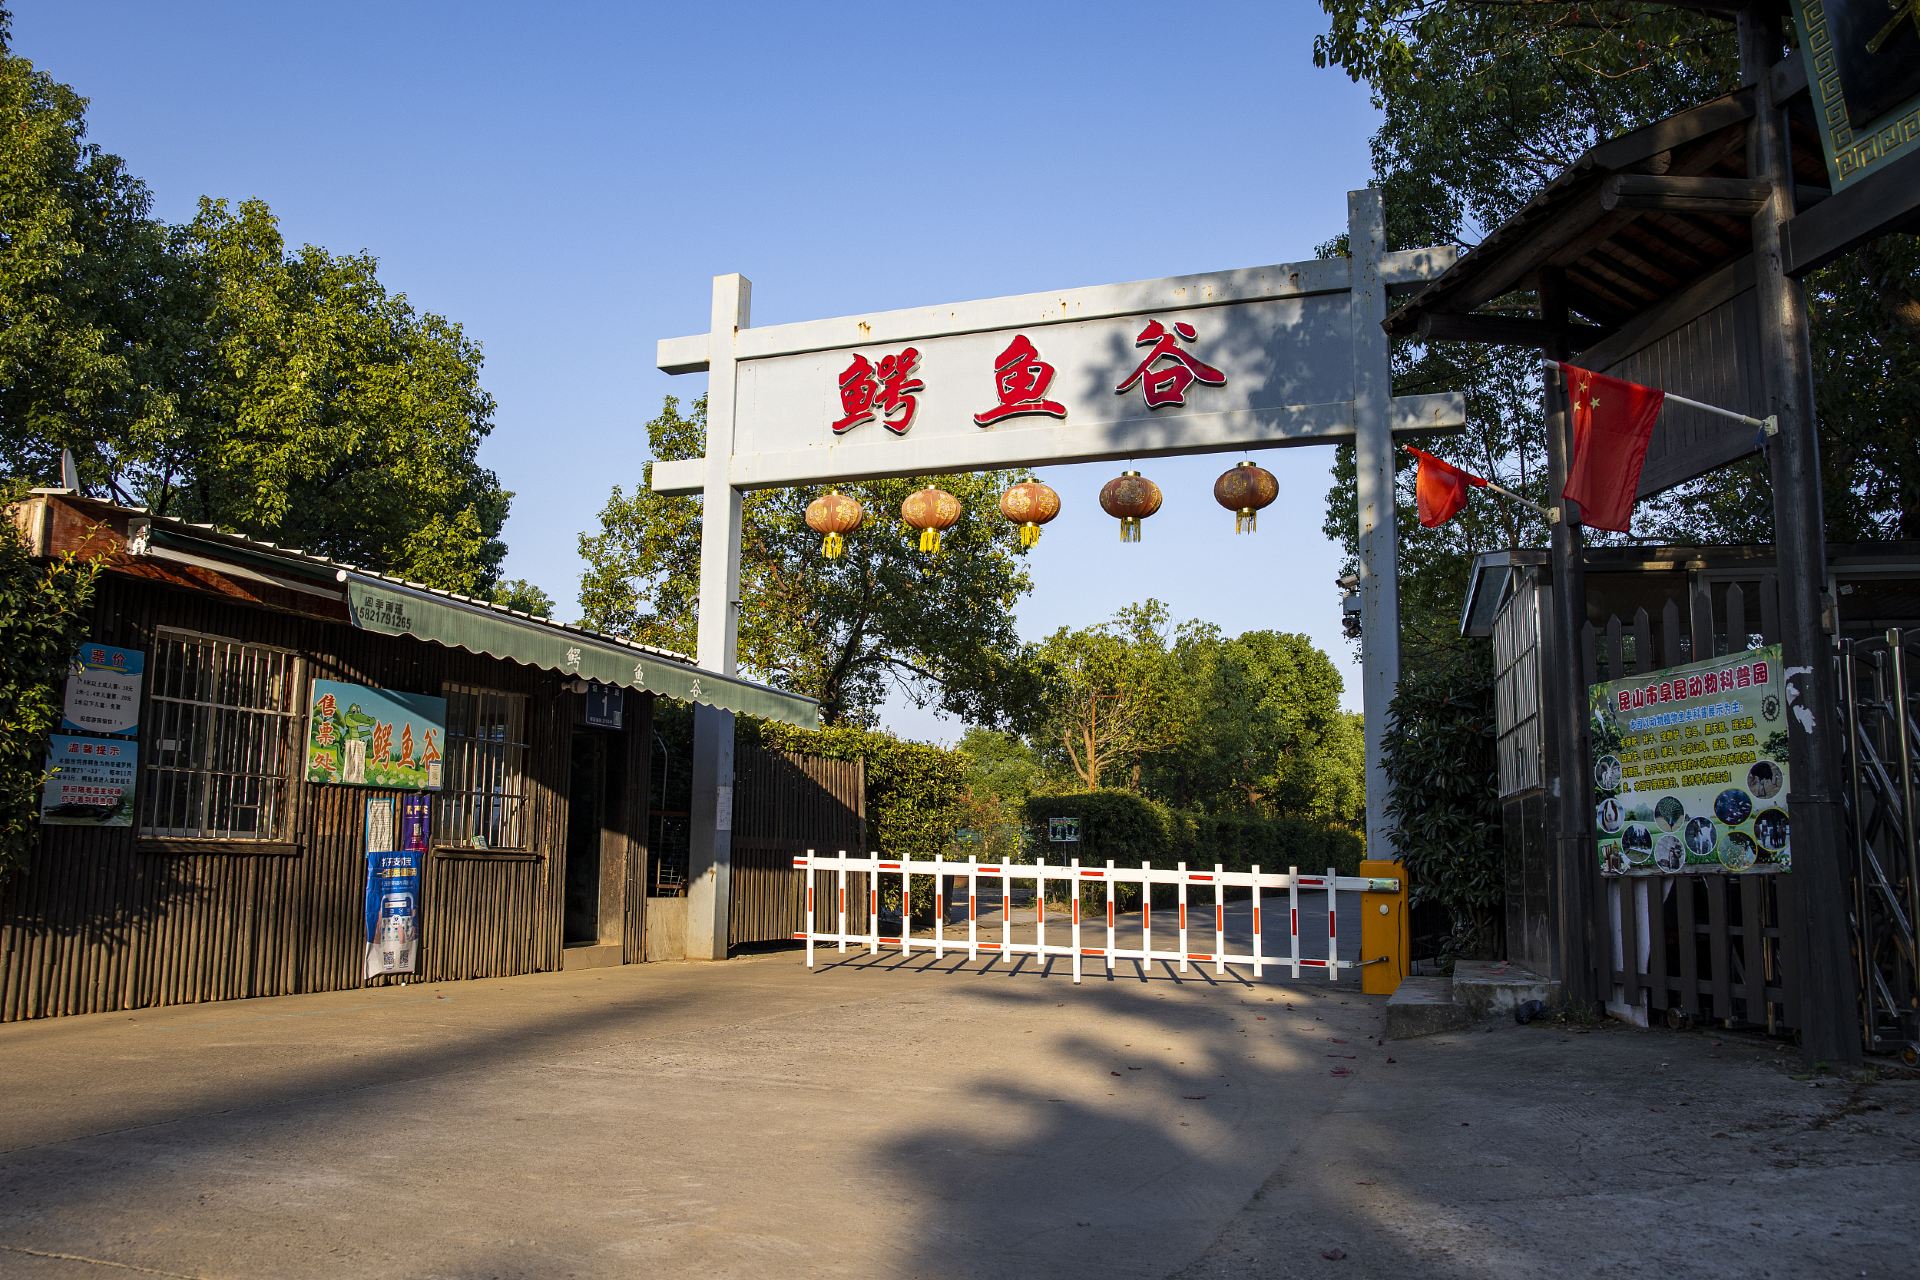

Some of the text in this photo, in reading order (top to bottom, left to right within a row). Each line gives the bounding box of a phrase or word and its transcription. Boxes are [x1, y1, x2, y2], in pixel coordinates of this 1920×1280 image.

[831, 318, 1228, 436] 鳄鱼谷
[91, 649, 125, 667] 票价
[566, 646, 702, 697] 鳄鱼谷
[602, 695, 608, 717] 1
[67, 742, 121, 757] 温馨提示
[313, 693, 337, 772] 售票处
[371, 720, 441, 772] 鳄鱼谷
